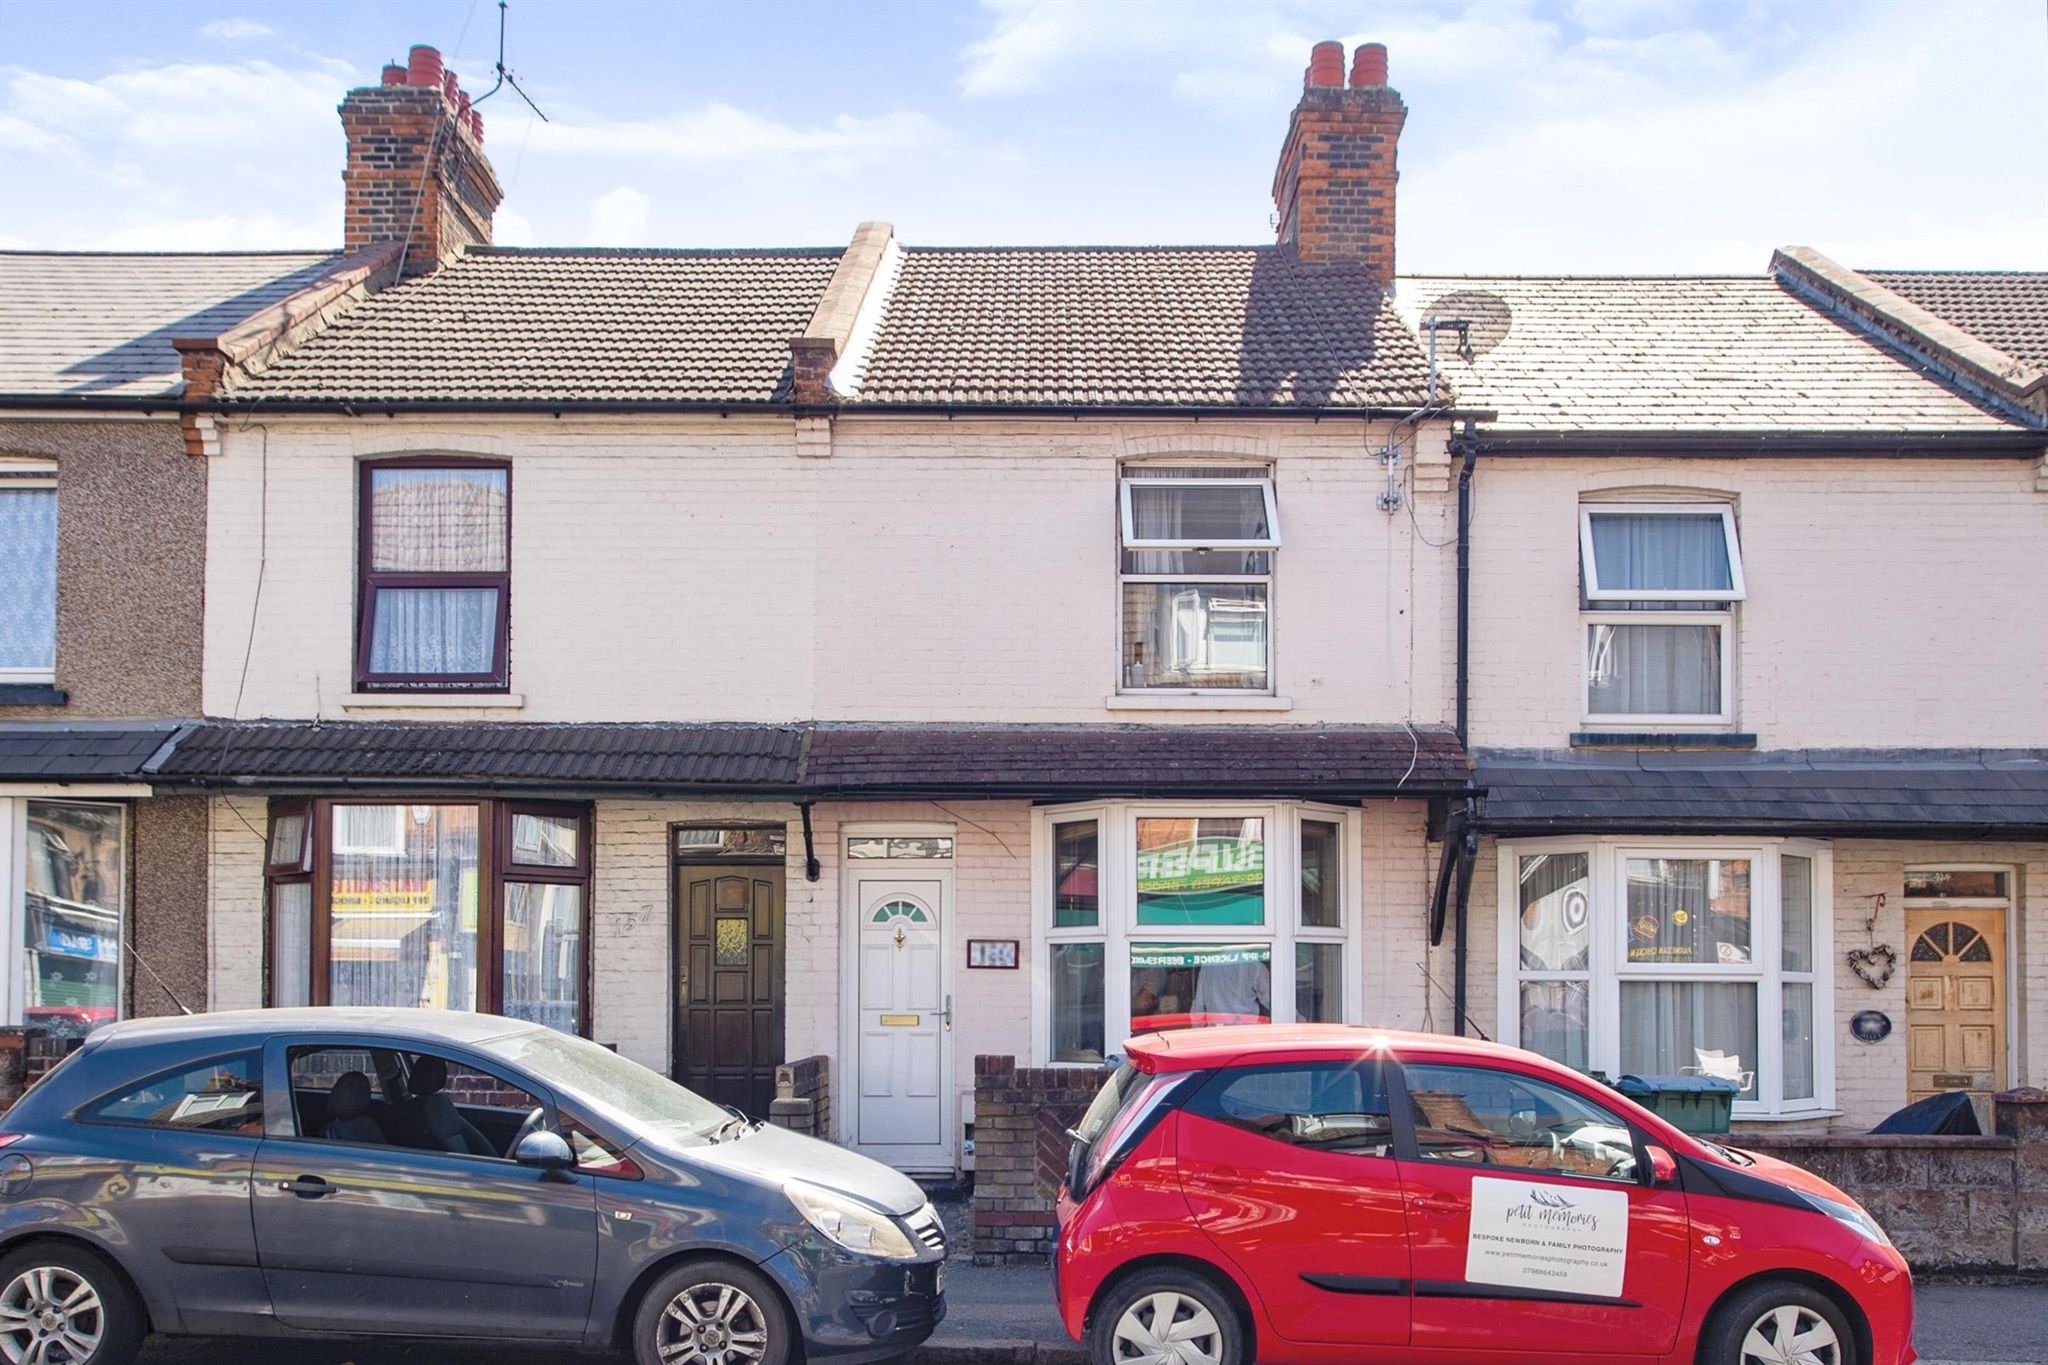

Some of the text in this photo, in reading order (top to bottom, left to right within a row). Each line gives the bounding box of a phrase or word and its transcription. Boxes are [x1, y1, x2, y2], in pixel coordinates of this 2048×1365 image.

[1506, 1203, 1600, 1232] petit memories
[1472, 1233, 1505, 1243] BESPOKE
[1506, 1236, 1540, 1246] NEWBORN
[1548, 1241, 1572, 1250] FAMILY
[1573, 1243, 1624, 1255] PHOTOGRAPHY
[1485, 1249, 1608, 1268] www.petitmemoriesphotography.co.uk
